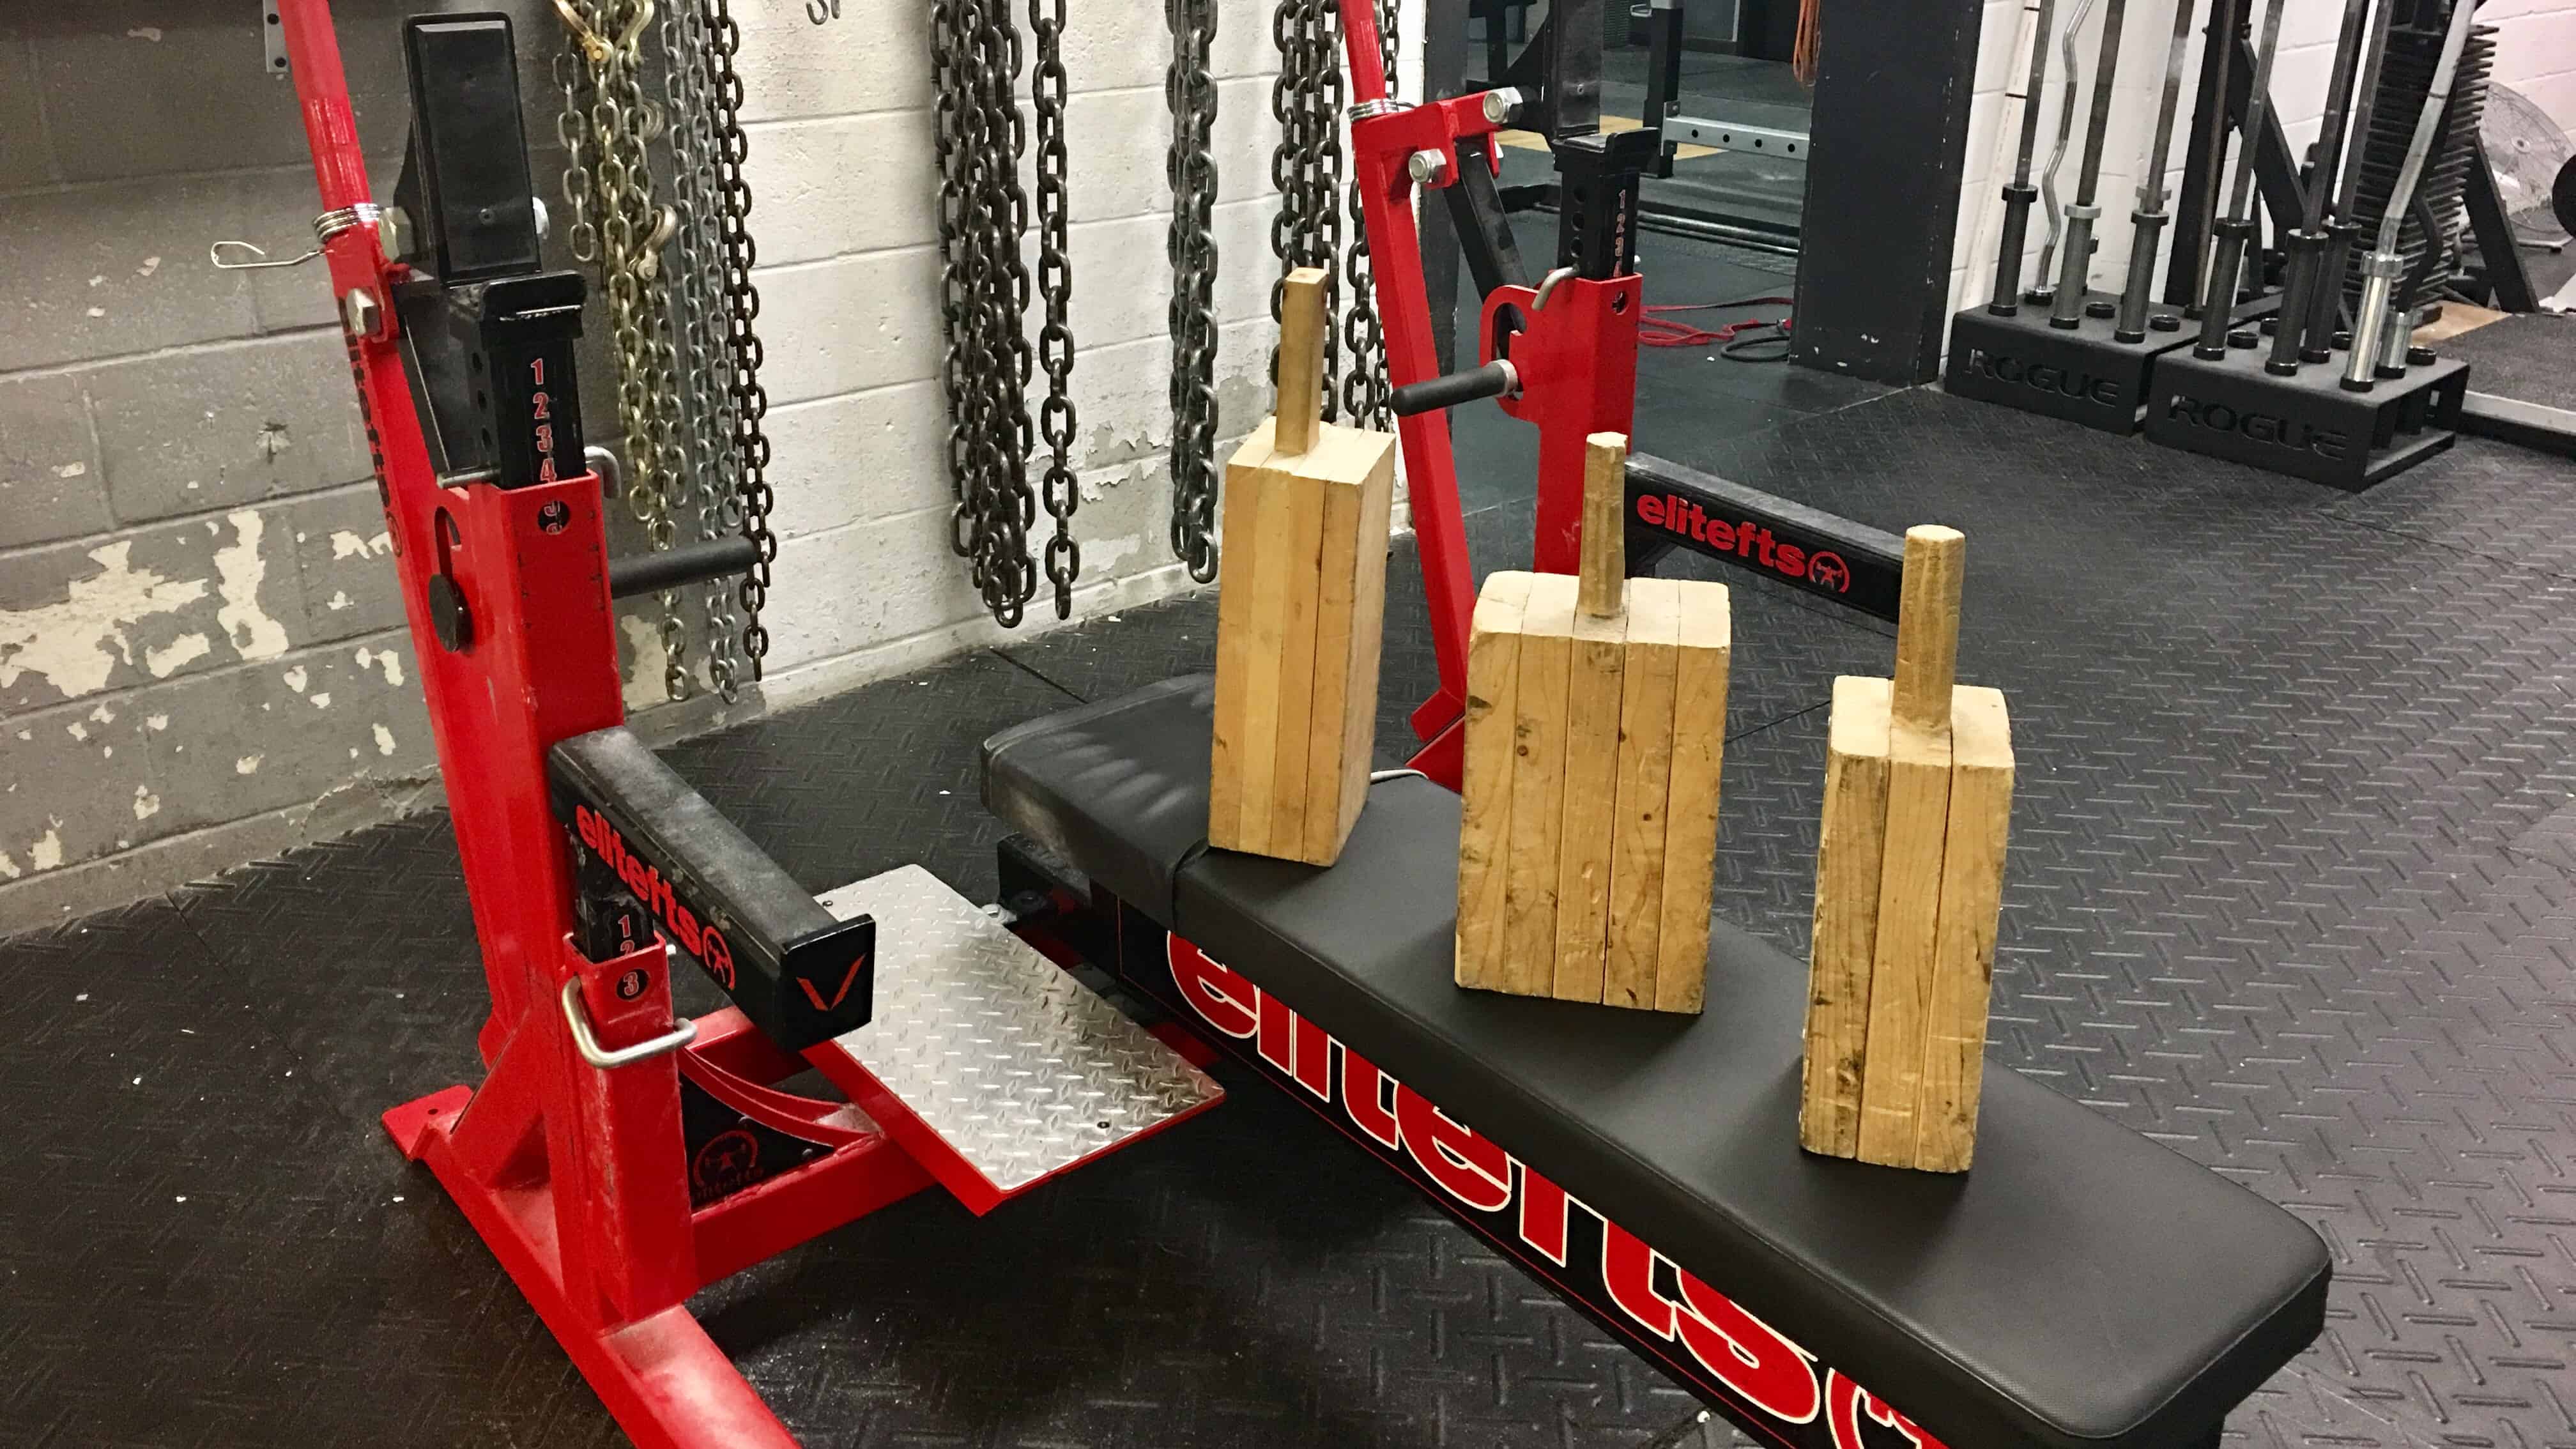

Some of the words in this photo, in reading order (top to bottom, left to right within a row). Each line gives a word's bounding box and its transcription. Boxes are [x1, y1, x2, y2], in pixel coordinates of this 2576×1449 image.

[1618, 189, 1626, 210] 1
[1616, 213, 1626, 233] 2
[1614, 237, 1624, 257] 3
[530, 358, 543, 385] 1
[1963, 348, 2120, 408] ROGUE
[533, 392, 550, 420] 2
[536, 424, 553, 452] 3
[2166, 394, 2348, 461] ROGUE
[540, 457, 557, 483] 4
[1636, 494, 1807, 578] elitefts
[576, 805, 702, 956] elitefts
[618, 914, 631, 939] 1
[623, 971, 640, 996] 3
